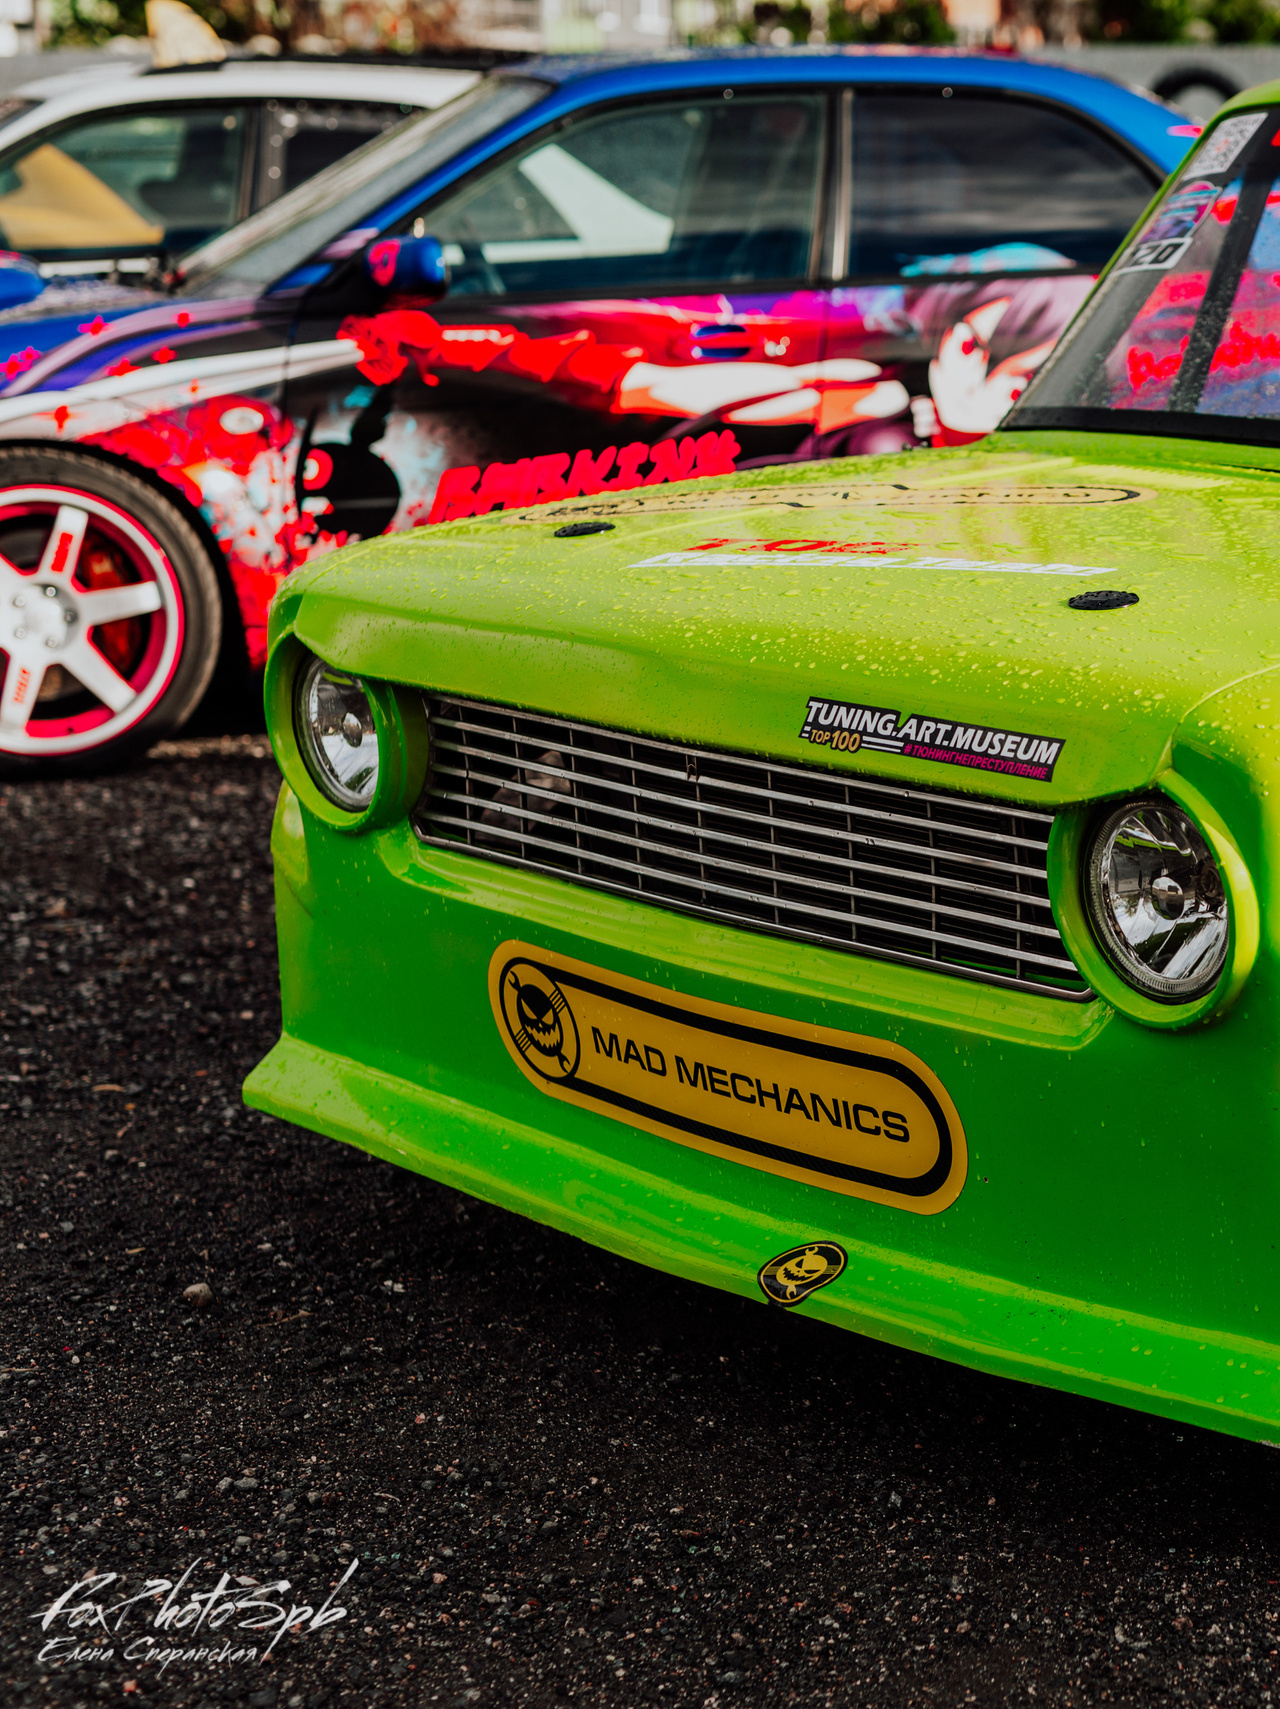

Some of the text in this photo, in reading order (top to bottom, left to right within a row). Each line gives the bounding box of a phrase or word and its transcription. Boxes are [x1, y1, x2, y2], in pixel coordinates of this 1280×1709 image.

[807, 701, 1060, 765] TUNING.ART.MUSEUM
[810, 728, 861, 752] TOP 100
[591, 1025, 910, 1143] MAD MECHANICS
